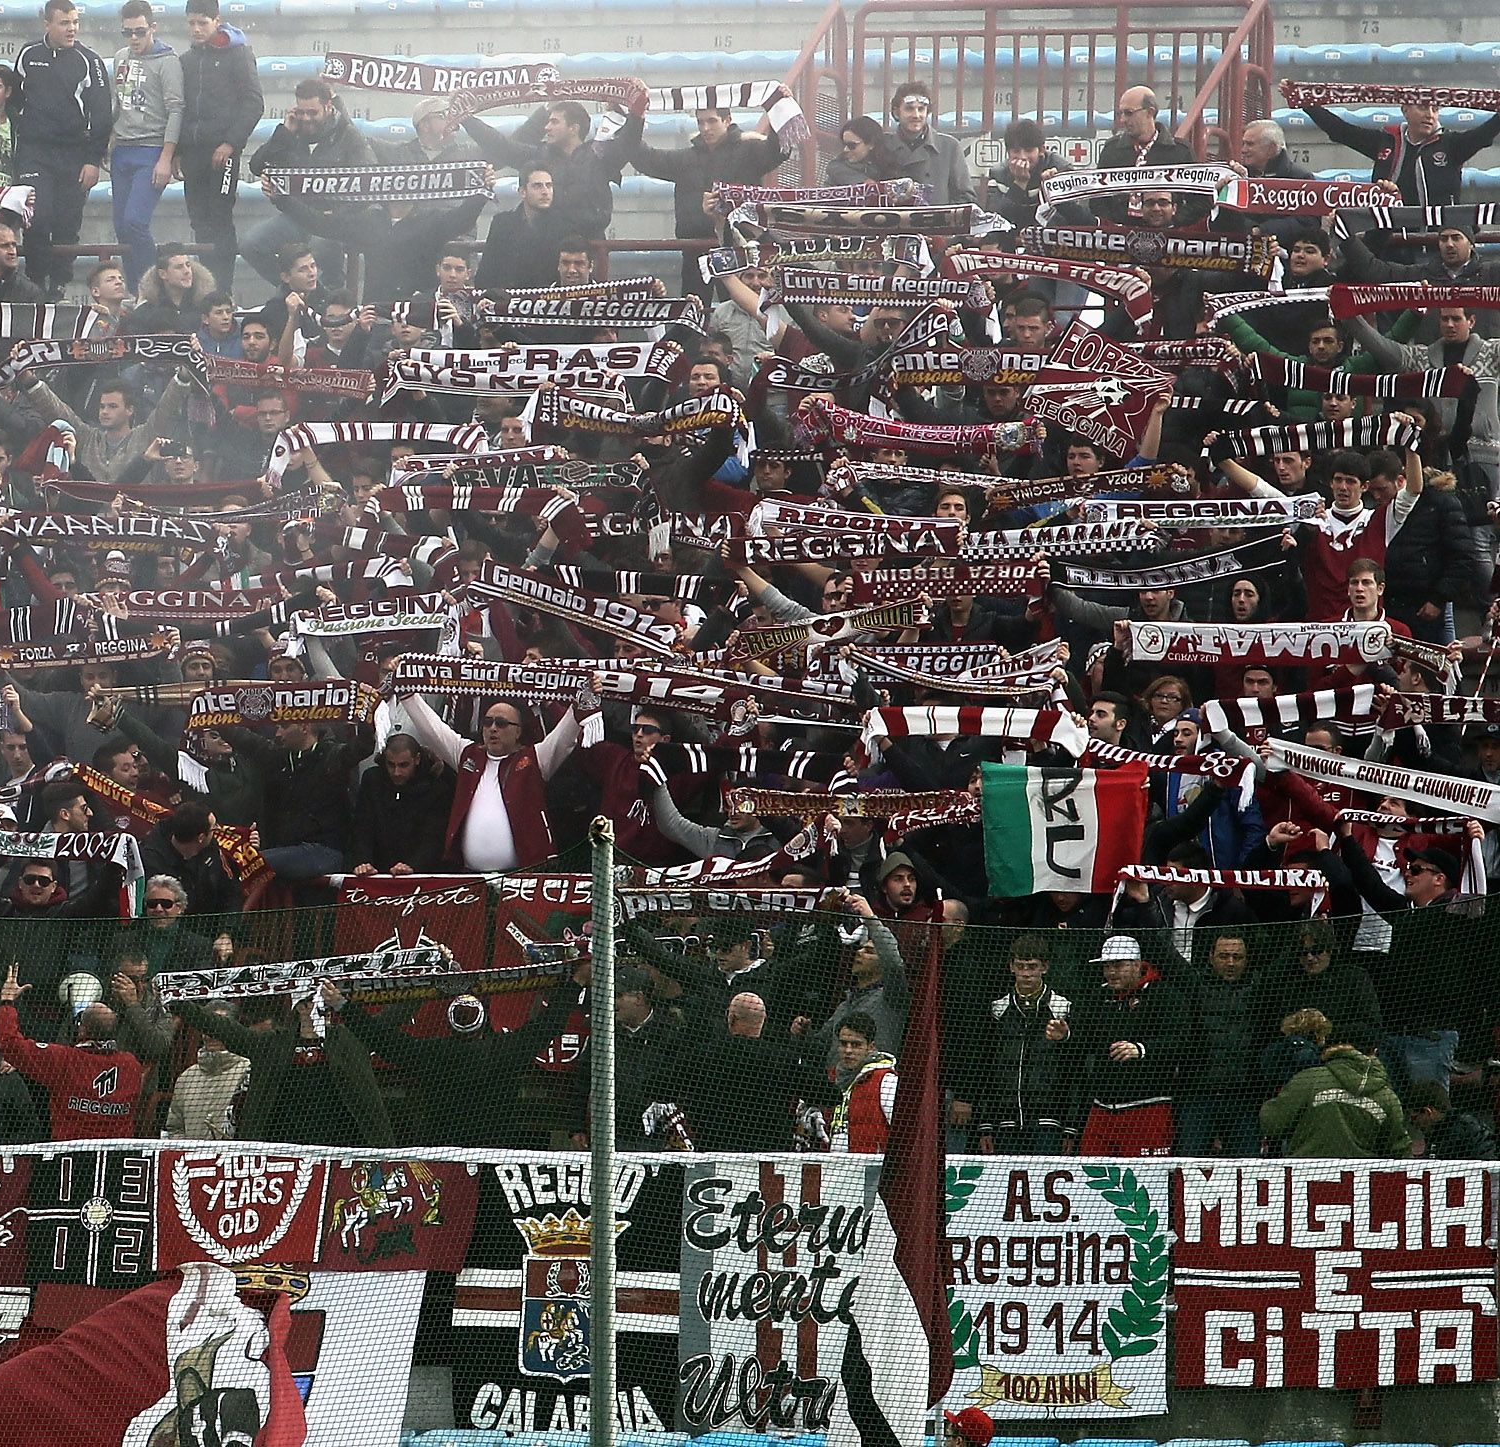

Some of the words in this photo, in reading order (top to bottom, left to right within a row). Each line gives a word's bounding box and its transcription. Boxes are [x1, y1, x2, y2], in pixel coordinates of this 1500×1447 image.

[348, 59, 422, 91] FORZA
[433, 66, 529, 91] REGGINA
[301, 175, 360, 194] FORZA
[368, 172, 454, 192] REGGINA
[1045, 173, 1090, 192] Reggina
[1110, 168, 1155, 183] Reggina
[1176, 168, 1221, 183] Reggina
[1250, 183, 1316, 209] Reggio
[1042, 228, 1126, 249] cente
[1167, 236, 1245, 259] nario
[1161, 254, 1238, 271] Secolare
[785, 271, 844, 290] Curva
[848, 275, 886, 292] Sud
[891, 278, 970, 296] Reggina
[508, 298, 572, 317] FORZA
[580, 301, 670, 318] REGGINA
[1050, 320, 1178, 381] FORZA
[1024, 393, 1128, 458] REGGINA
[1105, 470, 1144, 486] FORZA
[1011, 482, 1065, 501] REGGINA
[778, 507, 938, 531] REGGINA
[1117, 501, 1290, 517] REGGINA
[745, 529, 946, 563] REGGINA
[861, 568, 955, 584] REGGINA
[970, 566, 1038, 580] FORZA
[1065, 553, 1243, 587] REGGINA
[492, 564, 588, 612] Gennaio
[593, 599, 678, 645] 1914
[852, 605, 914, 628] REGGINA
[307, 614, 388, 633] Passione
[19, 647, 56, 661] FORZA
[95, 640, 148, 656] REGGINA
[749, 624, 809, 656] REGGINA
[396, 658, 454, 681] Curva
[459, 663, 501, 683] Sud
[507, 666, 588, 691] Reggina
[441, 678, 485, 689] Gennaio
[488, 680, 515, 690] 1914
[274, 684, 348, 706] nario
[639, 696, 717, 714] Tradizioni
[271, 705, 342, 721] Secolare
[1284, 749, 1355, 780] OVUNQUE...
[1356, 764, 1409, 790] CONTRO
[1412, 778, 1492, 809] CHIUNQUE!!!
[1343, 811, 1406, 824] VECCHIO
[58, 831, 118, 859] 2009
[700, 862, 771, 884] Tradizioni
[347, 887, 480, 916] trasferte
[501, 877, 535, 902] SE
[542, 878, 567, 902] CI
[709, 888, 818, 912] Curva
[200, 1174, 285, 1210] YEARS
[1002, 1168, 1081, 1224] A.S.
[216, 1207, 260, 1240] OLD
[946, 1229, 1132, 1286] Reggina
[1314, 1249, 1365, 1313] E
[974, 1299, 1104, 1356] 1914
[994, 1372, 1043, 1403] 100
[468, 1381, 666, 1437] CALABIA
